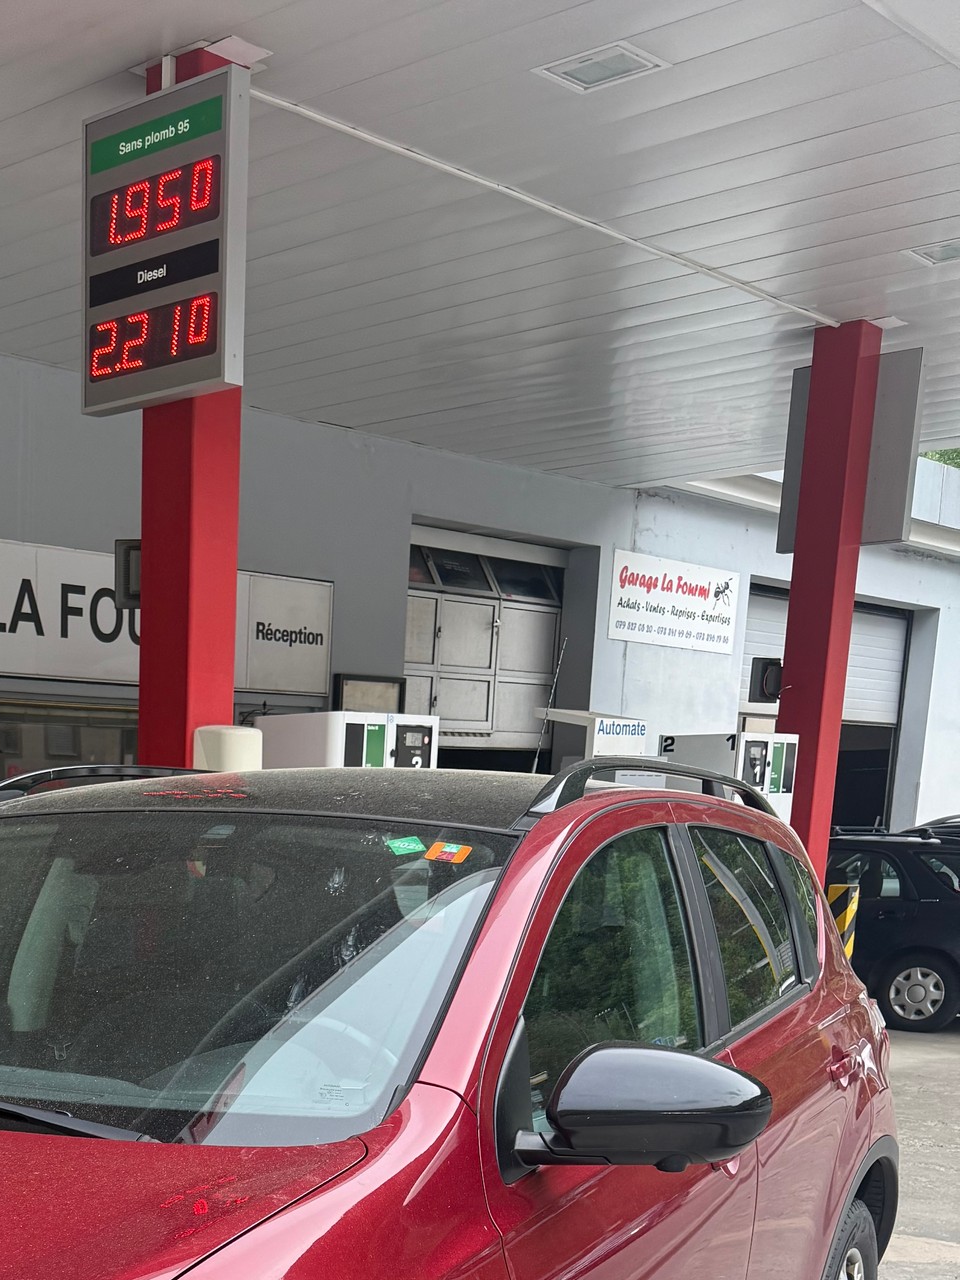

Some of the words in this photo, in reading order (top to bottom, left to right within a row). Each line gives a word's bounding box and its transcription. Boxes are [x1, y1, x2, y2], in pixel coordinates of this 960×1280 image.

[119, 138, 143, 155] Sans
[145, 125, 176, 149] plomb
[178, 119, 190, 134] 95
[137, 264, 167, 284] Diesel
[619, 565, 659, 594] Garage
[661, 573, 673, 593] La
[675, 575, 711, 601] Fourmi
[617, 596, 641, 612] Achats
[645, 601, 666, 616] Ventes
[670, 605, 696, 621] Reprises
[701, 610, 731, 626] Expertises
[256, 621, 323, 647] Réception
[597, 719, 646, 736] Automate
[663, 736, 675, 753] 2
[726, 734, 736, 751] 1
[753, 765, 760, 783] 1
